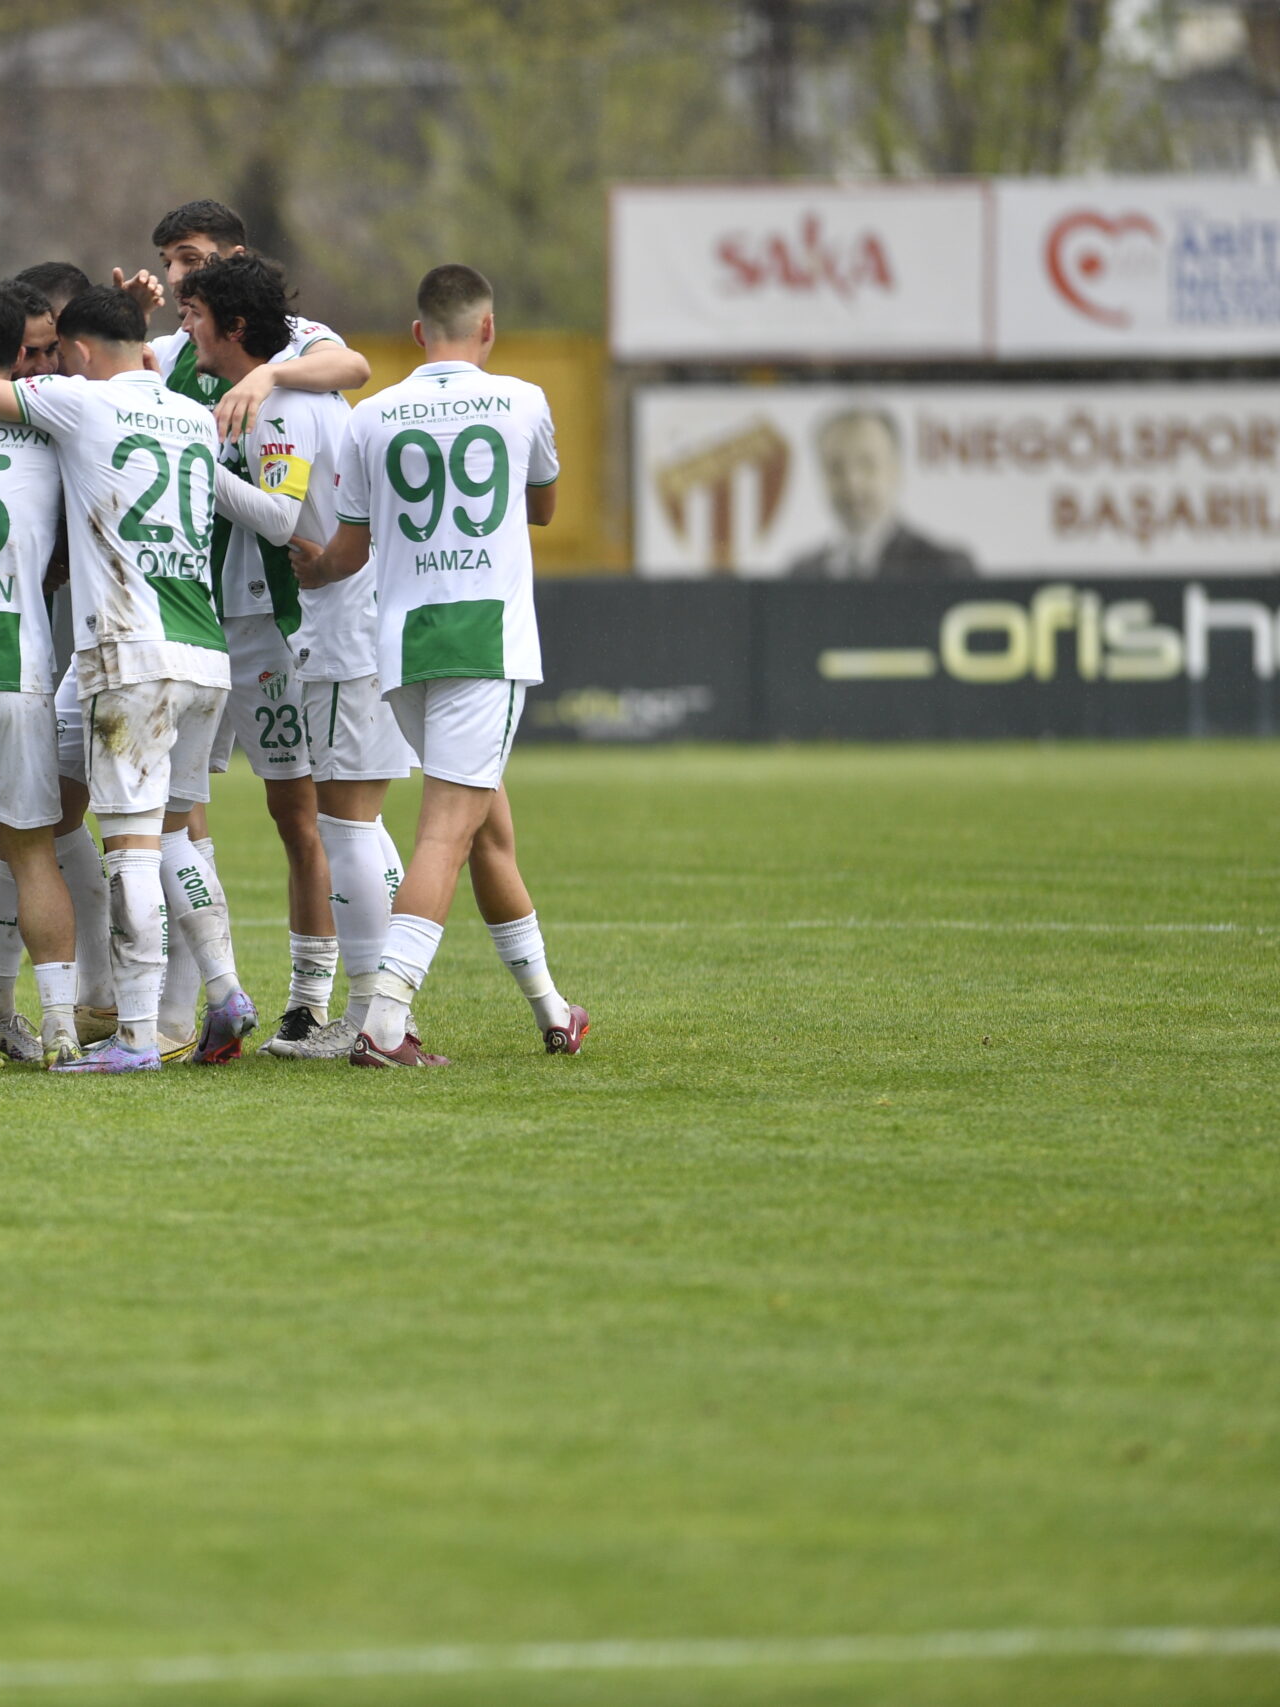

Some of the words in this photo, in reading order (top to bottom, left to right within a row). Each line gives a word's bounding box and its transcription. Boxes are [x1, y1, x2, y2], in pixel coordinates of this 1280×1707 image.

[111, 433, 216, 550] 20
[386, 424, 510, 542] 99
[136, 543, 208, 581] ÖMER
[415, 549, 492, 576] HAMZA
[255, 704, 302, 749] 23
[176, 865, 214, 910] aroma
